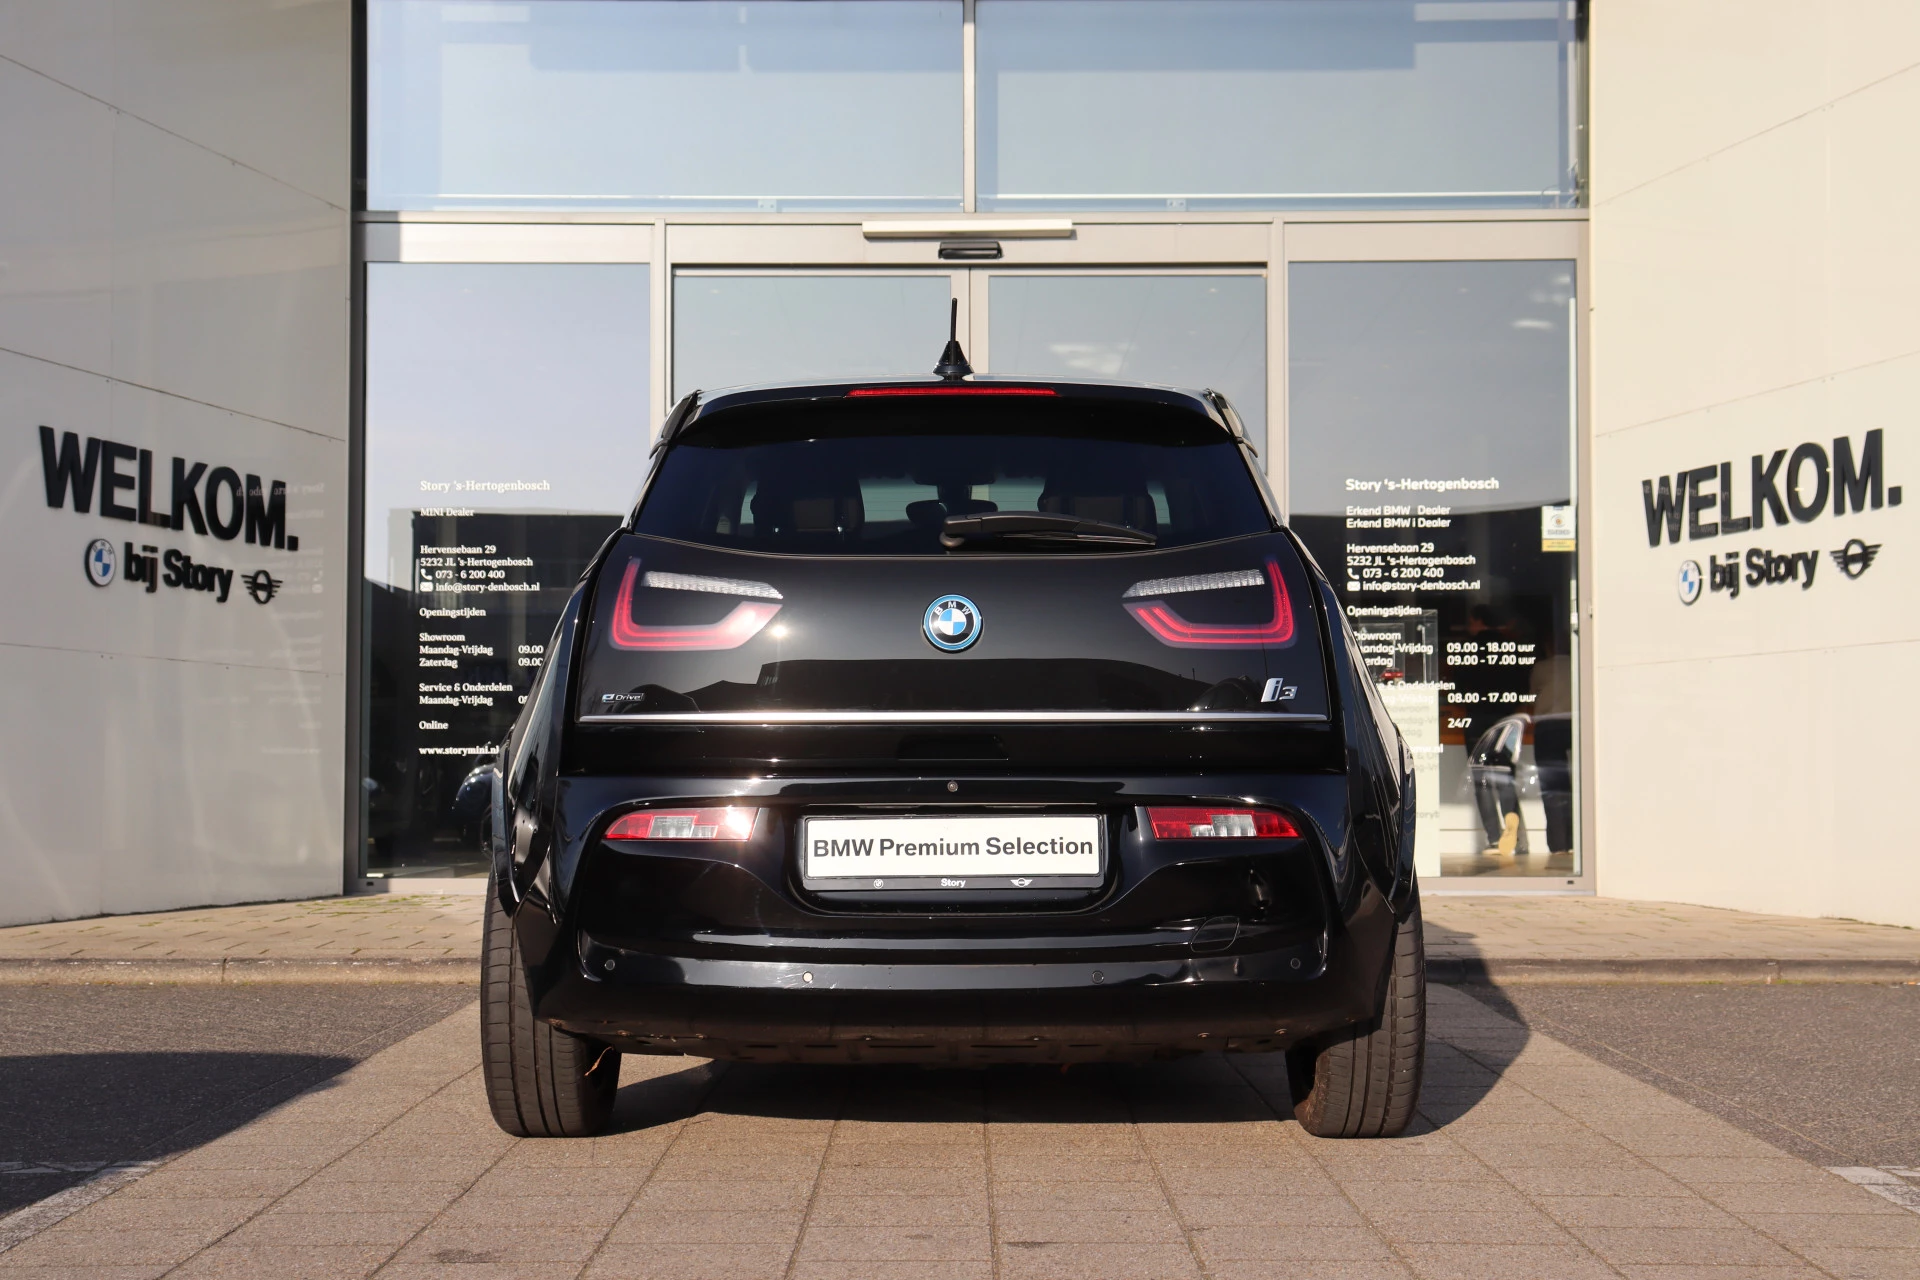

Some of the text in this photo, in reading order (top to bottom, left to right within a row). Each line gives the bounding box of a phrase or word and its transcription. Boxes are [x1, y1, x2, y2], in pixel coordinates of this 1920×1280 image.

[39, 425, 298, 551] WELKOM.
[420, 480, 450, 493] Story
[1345, 479, 1382, 492] Story
[1642, 428, 1902, 548] WELKOM.
[420, 508, 474, 516] MINI Dealer
[1346, 505, 1451, 516] Erkend BMW Dealer
[1346, 518, 1451, 528] Erkend BMW i Dealer
[420, 545, 496, 554] Hervensebaan 29
[1346, 542, 1434, 554] Hervensebaan 29
[420, 558, 443, 566] 5232
[444, 558, 456, 566] JL
[1346, 556, 1372, 566] 5232
[1373, 556, 1385, 566] JL
[124, 542, 233, 603] bij Story
[436, 570, 453, 578] 073
[460, 570, 467, 578] 6
[469, 570, 486, 578] 200
[488, 570, 505, 578] 400
[1362, 568, 1382, 578] 073
[1391, 568, 1398, 578] 6
[1400, 568, 1421, 578] 200
[1423, 568, 1444, 578] 400
[1710, 548, 1819, 600] bij Story
[436, 582, 540, 593] info@story-denbosch.nl
[1362, 580, 1480, 592] info@story-denbosch.nl
[420, 607, 486, 618] Openingstijden
[1346, 606, 1422, 618] Openingstijden
[419, 633, 466, 642] Showroom
[1354, 631, 1402, 640] howroom
[419, 645, 544, 656] Maandag-Vrijdag 09.00
[1447, 642, 1478, 652] 09.00
[1487, 642, 1516, 652] 18.00
[1518, 644, 1536, 652] uur
[419, 658, 458, 669] Zaterdag
[1364, 656, 1393, 668] erdag
[1447, 656, 1478, 666] 09.00
[1518, 656, 1536, 665] uur
[419, 683, 513, 692] Service & Onderdelen
[1261, 678, 1298, 702] i3
[1398, 680, 1456, 690] Onderdelen
[419, 696, 493, 706] Maandag-Vrijdag
[1448, 693, 1480, 703] 08.00
[1519, 694, 1536, 702] uur
[419, 721, 449, 730] Online
[1447, 718, 1472, 728] 24/7
[419, 746, 500, 756] www.storymini.nl
[813, 836, 1093, 857] BMW Premium Selection
[941, 878, 966, 888] Story
